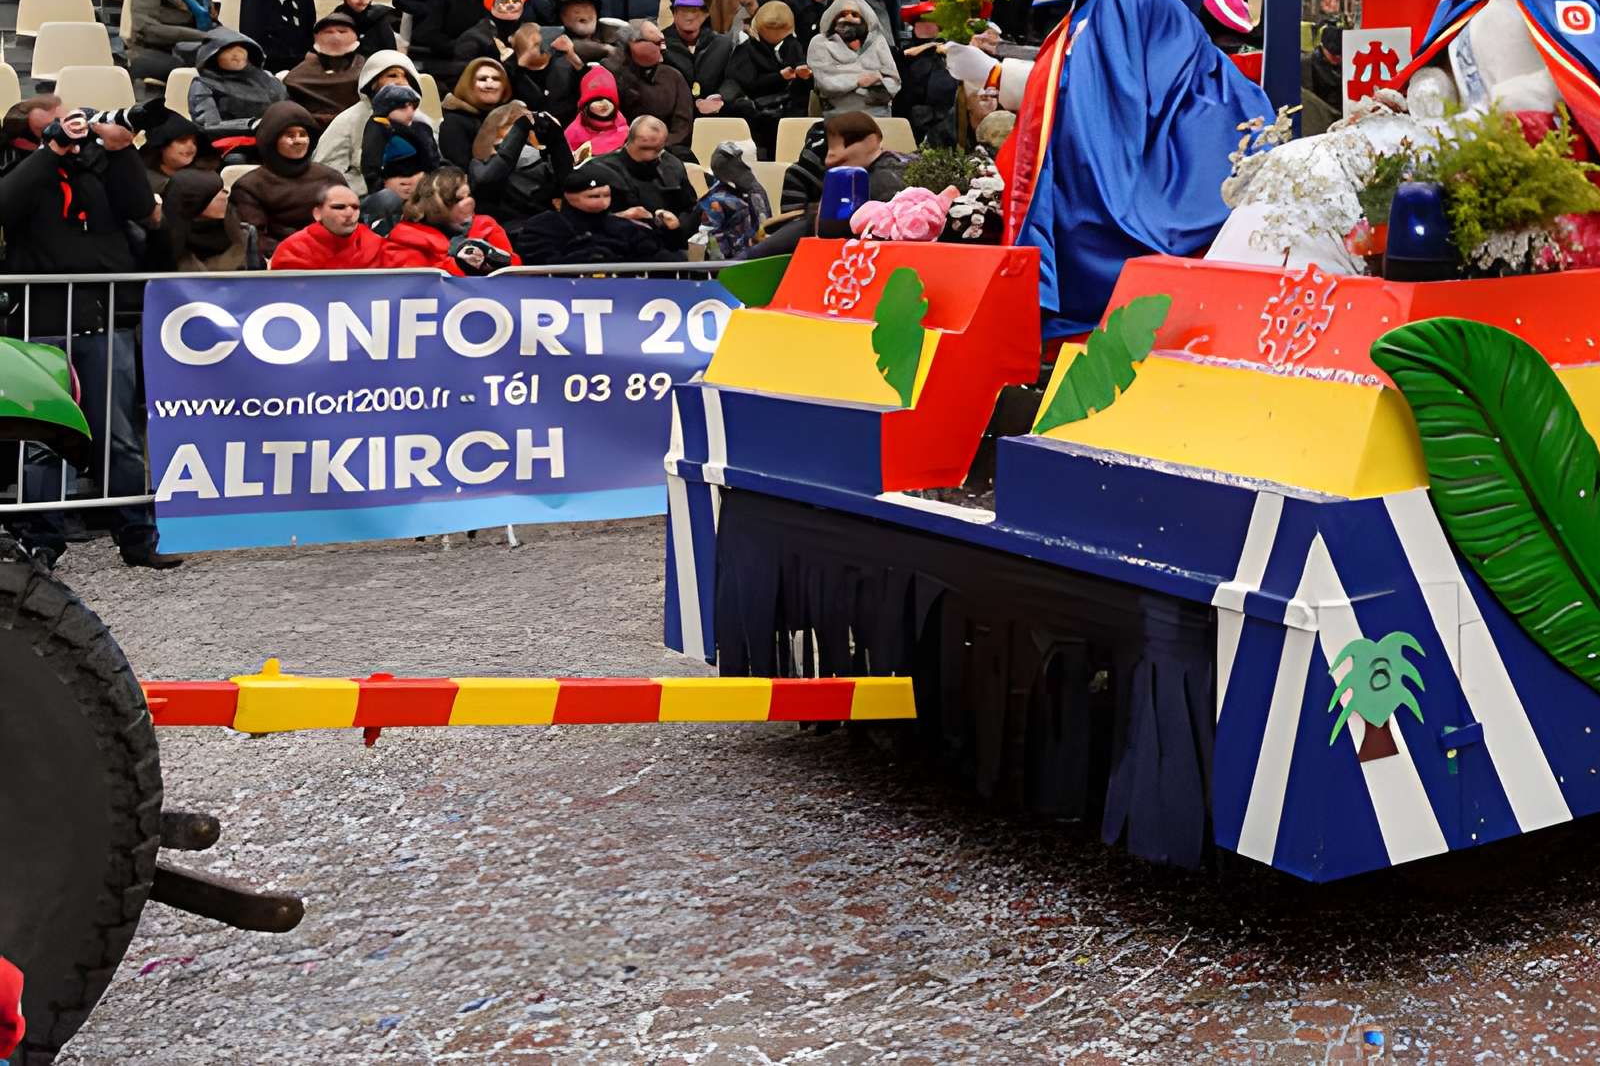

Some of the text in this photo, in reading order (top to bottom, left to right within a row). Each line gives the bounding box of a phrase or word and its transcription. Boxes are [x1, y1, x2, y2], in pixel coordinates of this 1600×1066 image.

[160, 297, 613, 366] CONFORT
[155, 386, 450, 418] www.confort2000.fr
[483, 371, 539, 407] Tél
[563, 374, 612, 403] 03
[625, 372, 673, 402] 89
[155, 427, 566, 502] ALTKIRCH
